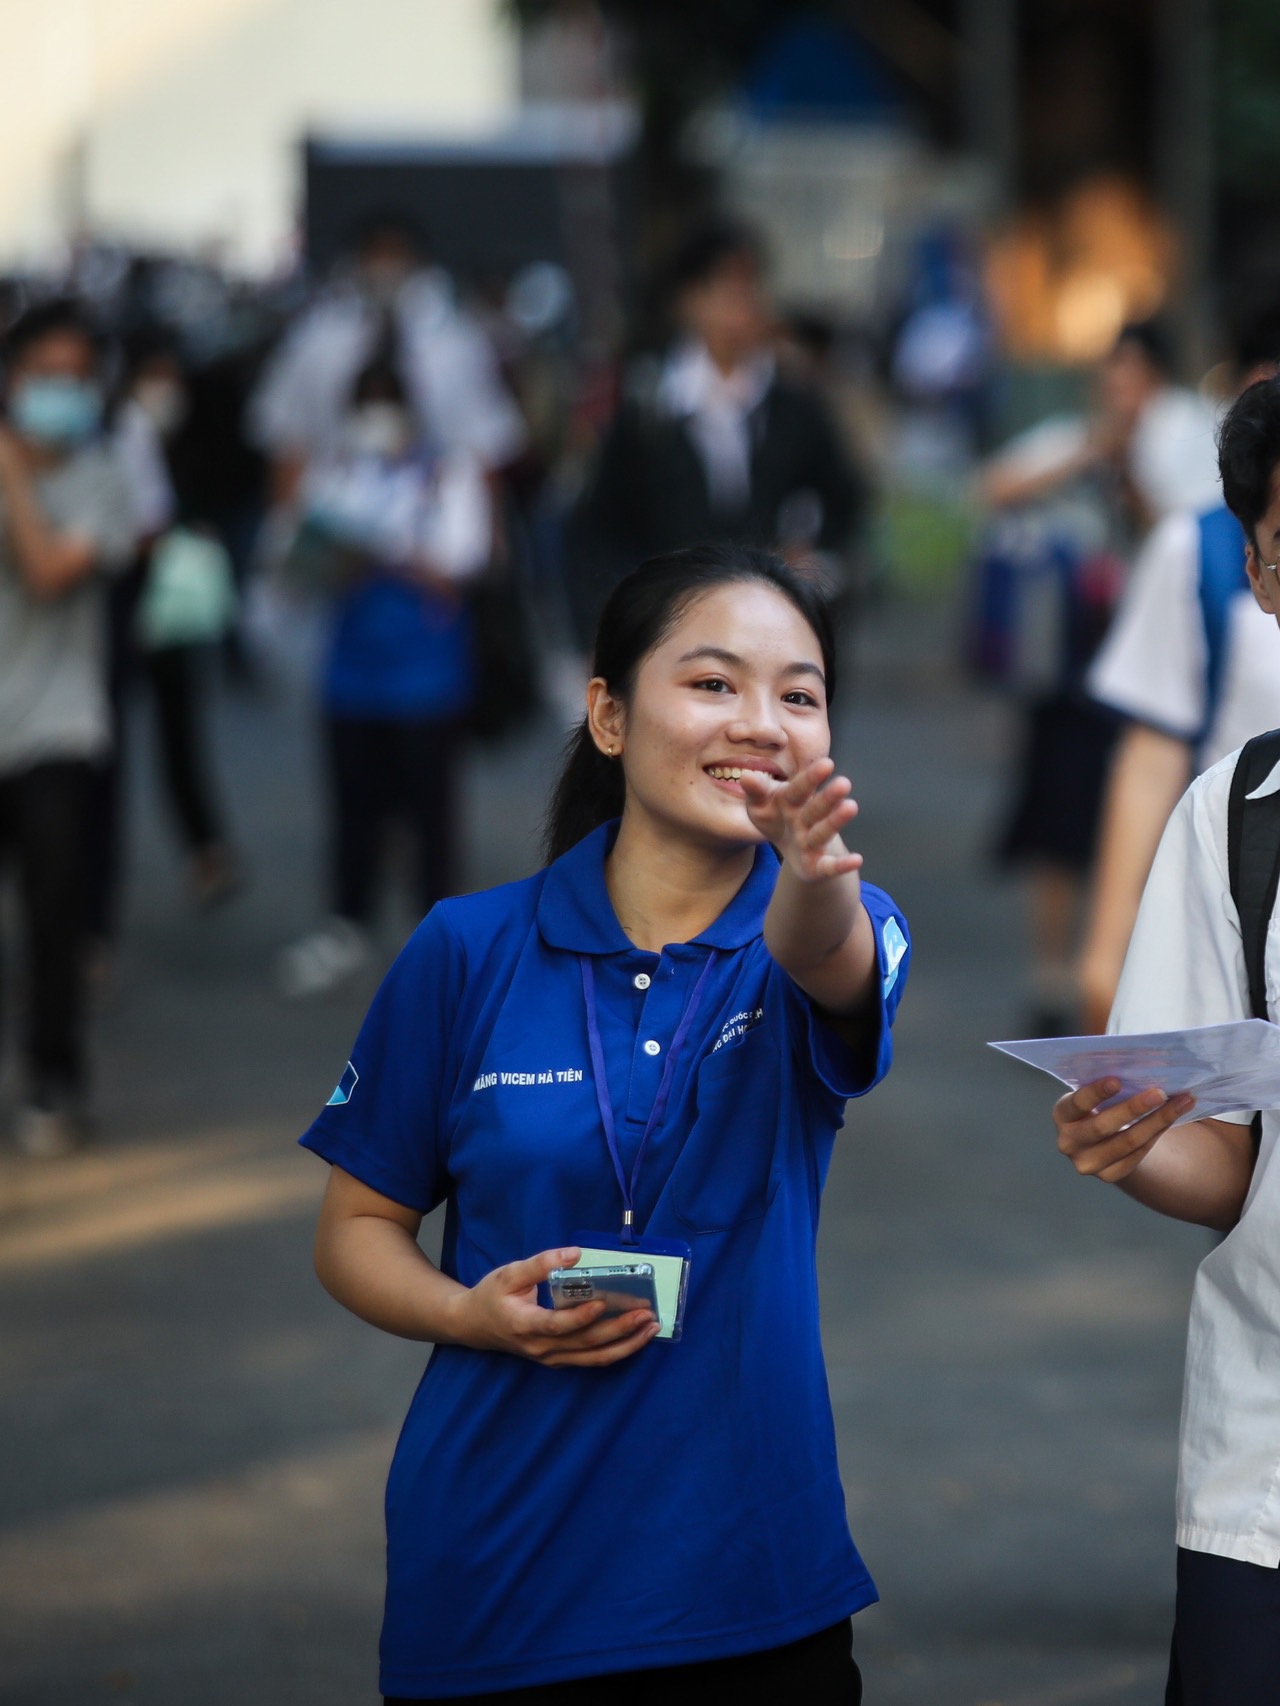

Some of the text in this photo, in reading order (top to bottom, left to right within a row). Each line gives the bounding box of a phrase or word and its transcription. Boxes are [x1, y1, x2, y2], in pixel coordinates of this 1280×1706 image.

[500, 1072, 536, 1085] VICEM
[538, 1069, 554, 1084] HÀ
[556, 1068, 583, 1082] TIÊN
